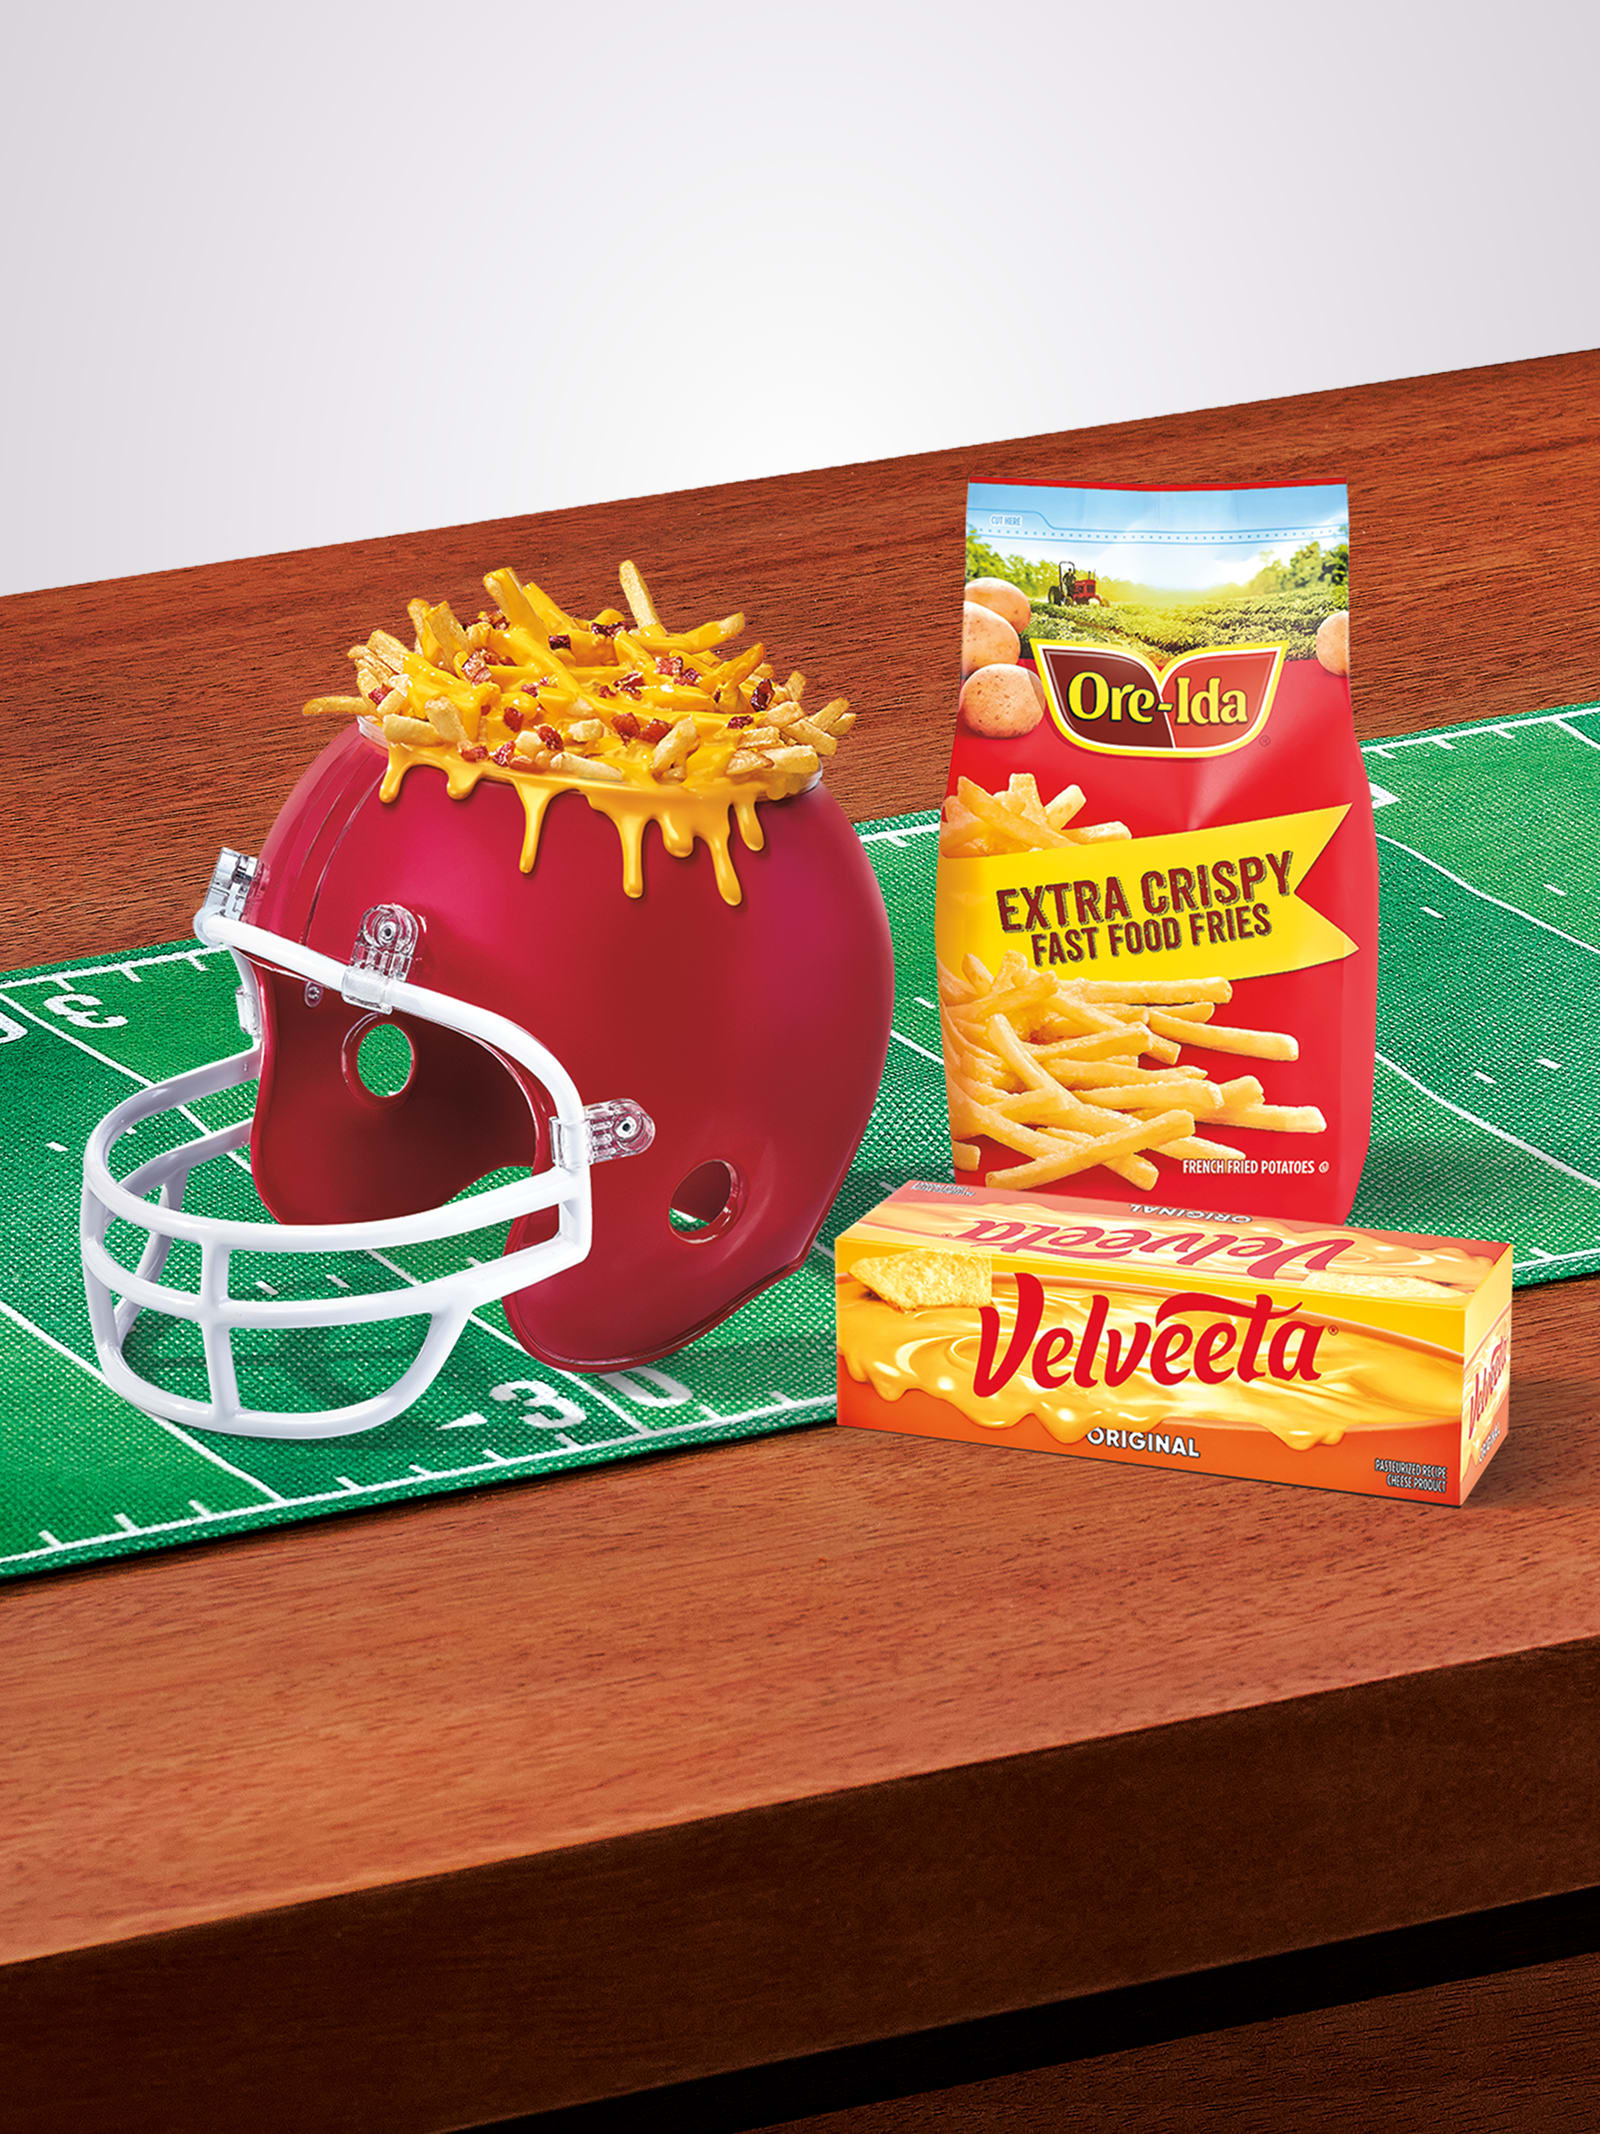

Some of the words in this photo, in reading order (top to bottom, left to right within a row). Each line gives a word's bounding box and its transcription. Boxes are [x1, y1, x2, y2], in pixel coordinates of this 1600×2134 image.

[1067, 671, 1248, 727] Ore-Ida
[996, 876, 1132, 933] EXTRA
[1140, 850, 1294, 915] CRISPY
[1031, 926, 1099, 967] FAST
[1107, 916, 1183, 957] FOOD
[1189, 902, 1273, 947] FRIES
[1182, 1159, 1225, 1174] FRENCH
[1227, 1160, 1258, 1174] FRIED
[1261, 1160, 1315, 1174] POTATOES
[1128, 1203, 1253, 1224] ORIGINAL
[955, 1219, 1356, 1279] Velveeta
[973, 1272, 1324, 1398] Velveeta
[1086, 1427, 1201, 1458] ORIGINAL
[1375, 1458, 1421, 1476] PASTEURIZED
[1422, 1464, 1447, 1479] RECIPE
[1386, 1473, 1413, 1488] CHEESE
[1413, 1477, 1447, 1493] PRODUCT
